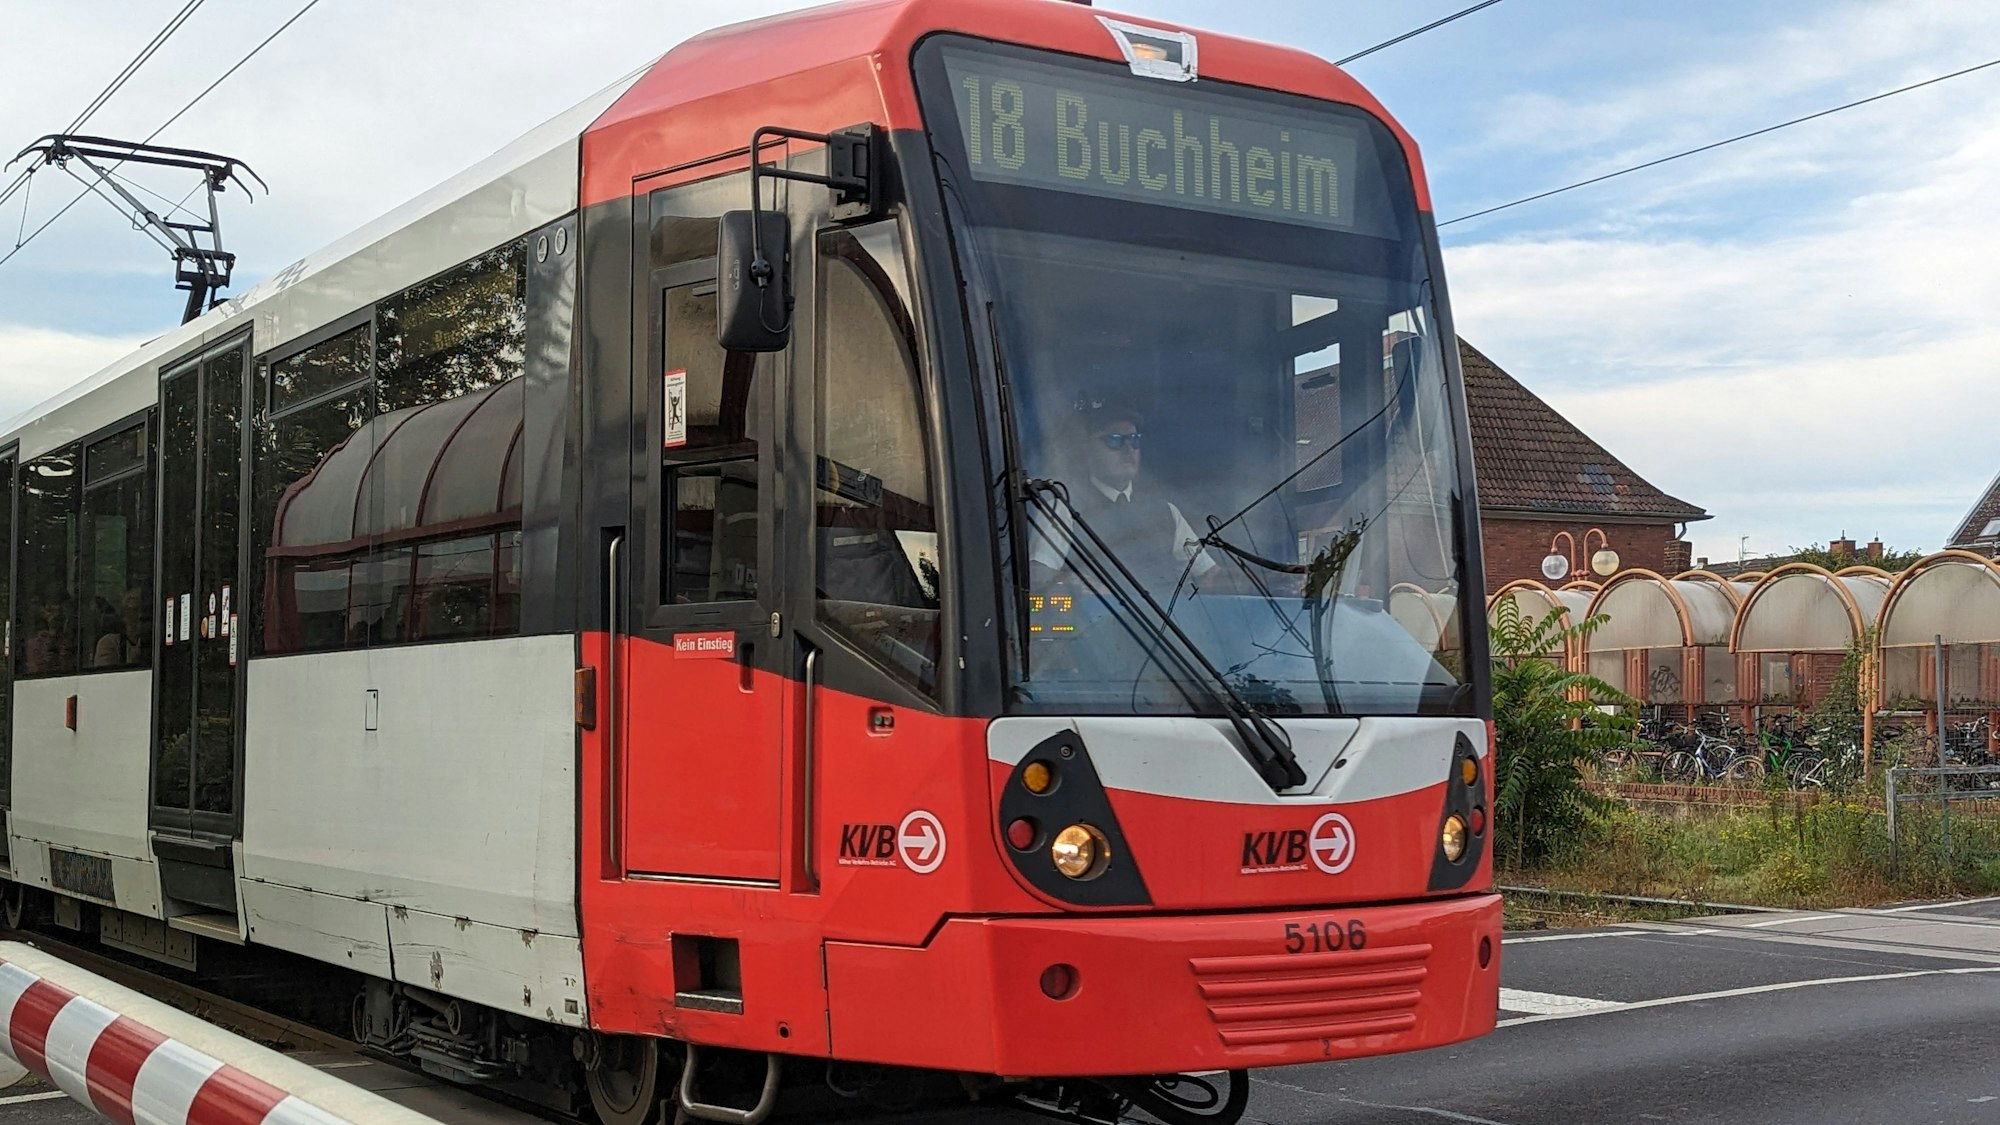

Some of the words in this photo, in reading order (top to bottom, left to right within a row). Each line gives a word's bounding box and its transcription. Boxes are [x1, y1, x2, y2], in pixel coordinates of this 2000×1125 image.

[962, 75, 1026, 171] 18
[1056, 88, 1339, 218] Buchheim
[676, 638, 696, 651] Kein
[697, 637, 733, 653] Einstieg
[840, 824, 896, 858] KVB
[1241, 829, 1308, 867] KVB
[1284, 919, 1367, 954] 5106
